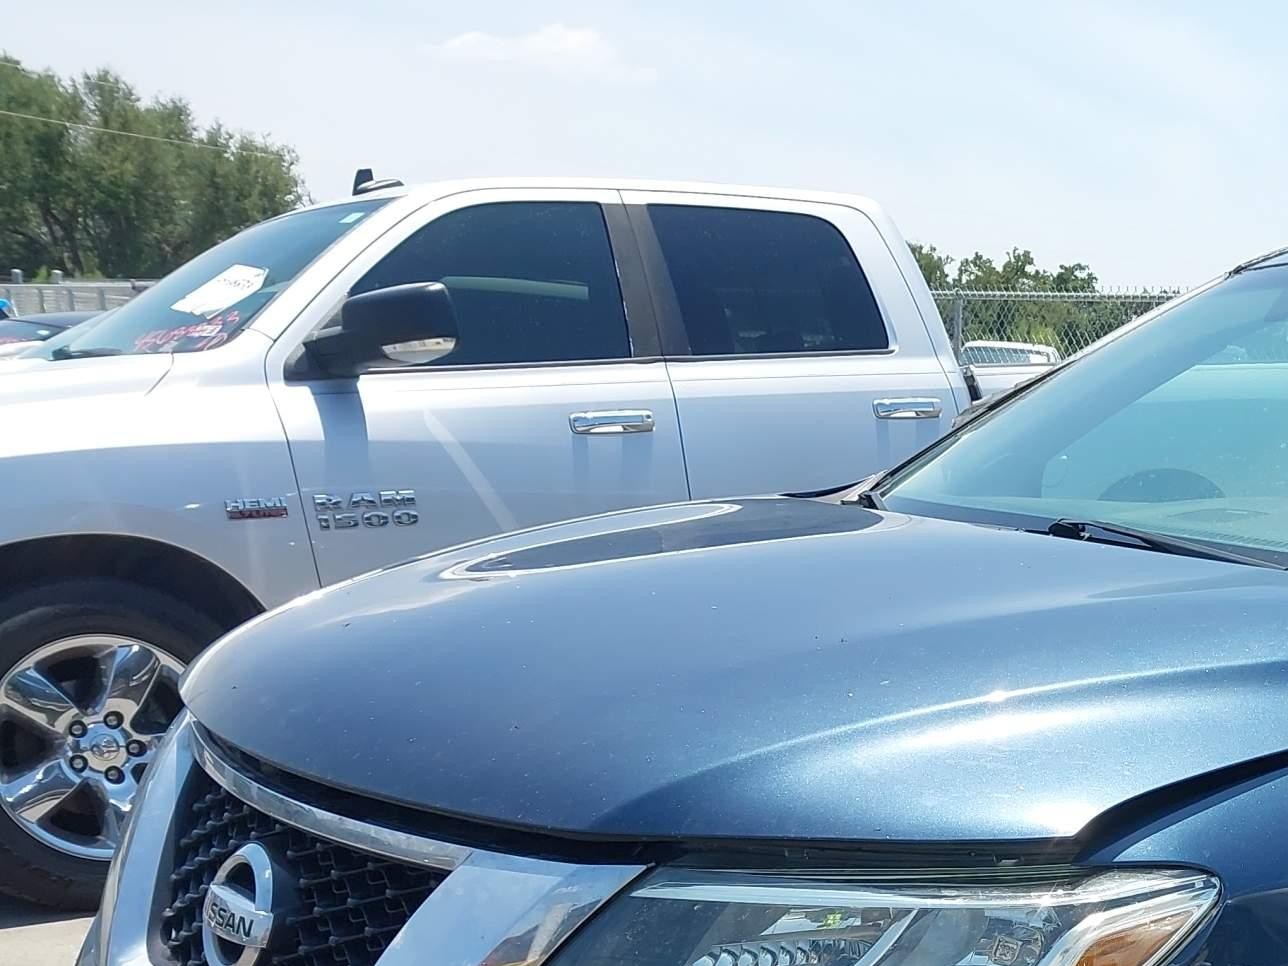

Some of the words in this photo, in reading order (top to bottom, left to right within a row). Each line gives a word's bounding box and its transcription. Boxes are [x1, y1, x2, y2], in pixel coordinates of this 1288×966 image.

[225, 496, 287, 511] HEMI
[313, 489, 417, 511] RAM
[317, 509, 419, 531] 1500
